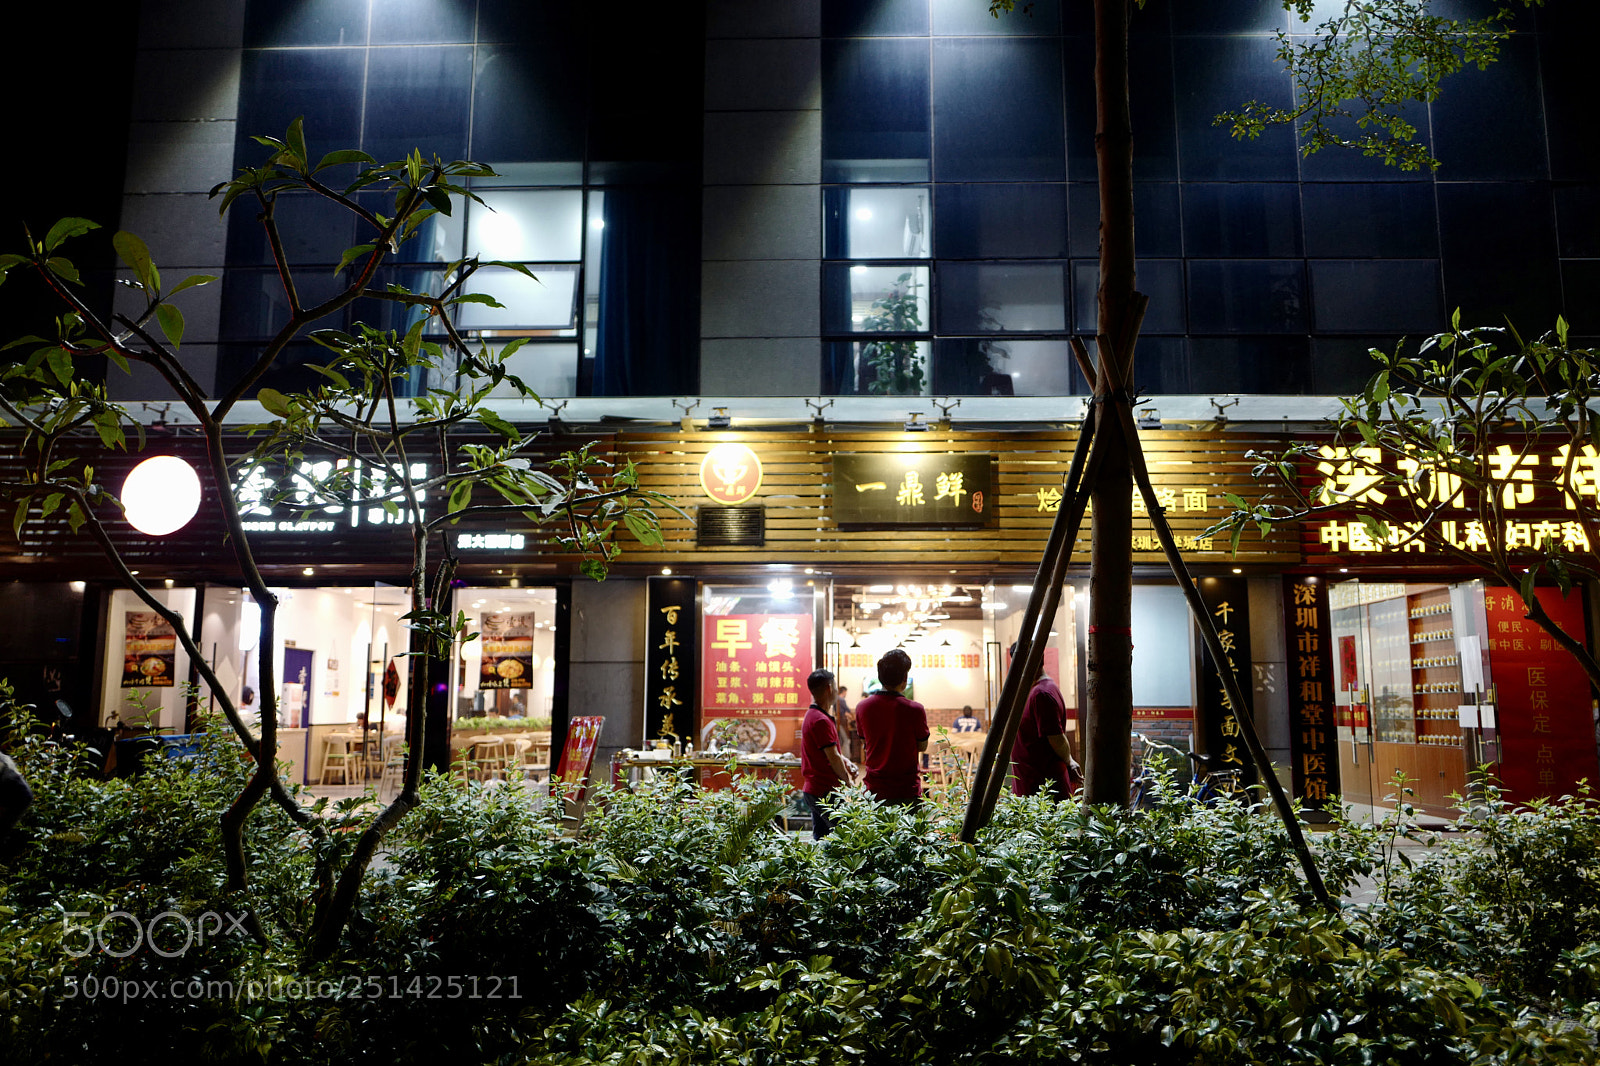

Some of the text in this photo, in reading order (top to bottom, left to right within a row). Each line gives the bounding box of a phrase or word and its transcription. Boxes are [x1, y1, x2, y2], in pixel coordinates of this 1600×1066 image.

[855, 470, 967, 507] 一鼎鲜
[278, 521, 335, 531] CLAYPOT
[1484, 594, 1530, 612] 好消
[711, 617, 801, 659] 早餐
[1497, 620, 1563, 633] 便民、
[1214, 600, 1243, 766] 千家面文
[1293, 583, 1328, 801] 深圳市祥和堂中医馆
[1527, 666, 1557, 803] 医保定点单
